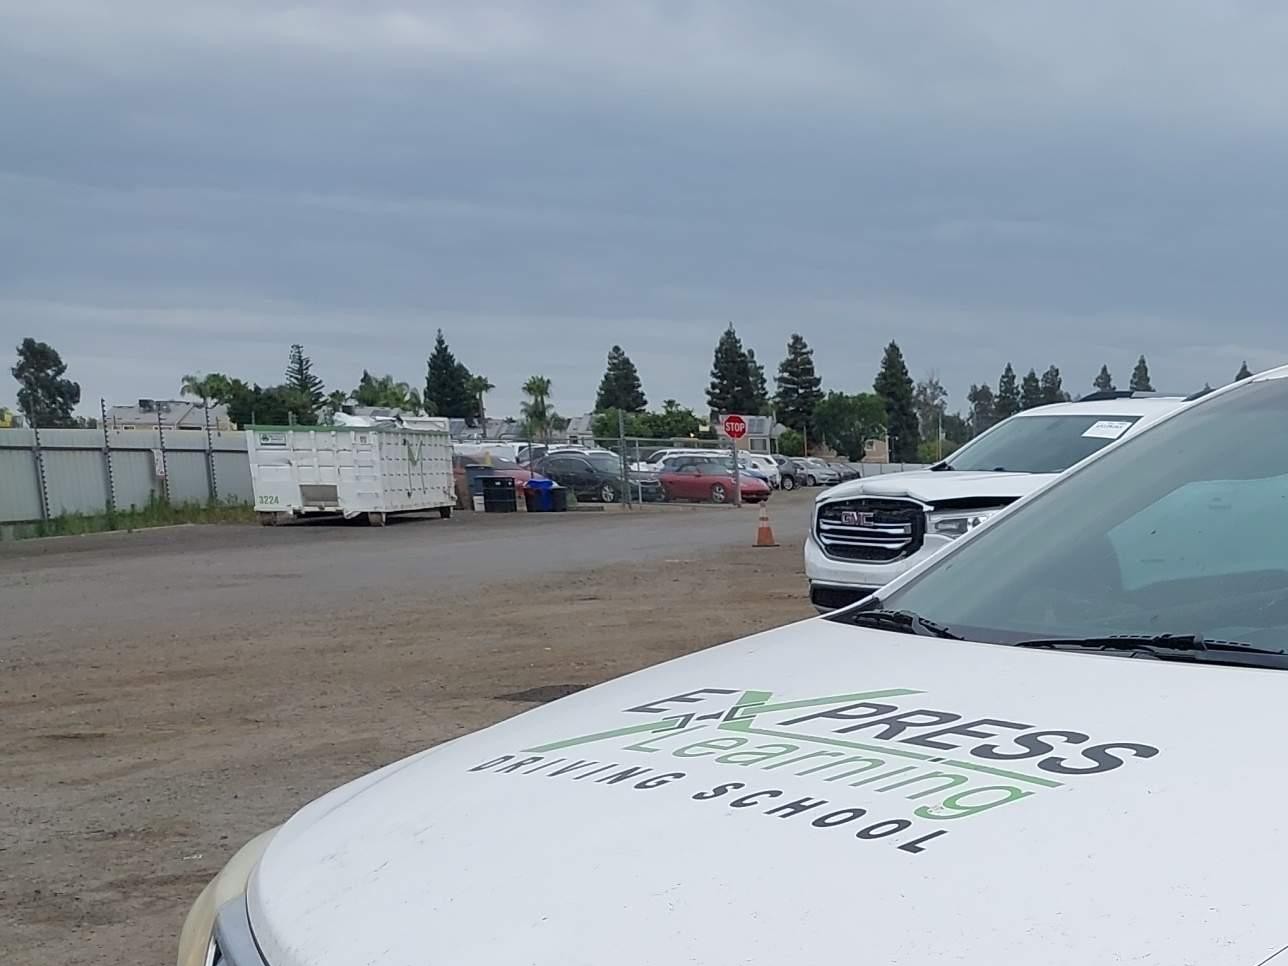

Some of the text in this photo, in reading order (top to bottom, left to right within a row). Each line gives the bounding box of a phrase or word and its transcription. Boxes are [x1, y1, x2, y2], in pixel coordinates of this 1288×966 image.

[725, 422, 745, 433] STOP
[841, 511, 874, 527] GMC
[622, 723, 1036, 821] Learning
[623, 686, 1160, 776] EXPRESS
[468, 753, 949, 854] DRIVING SCHOOL
